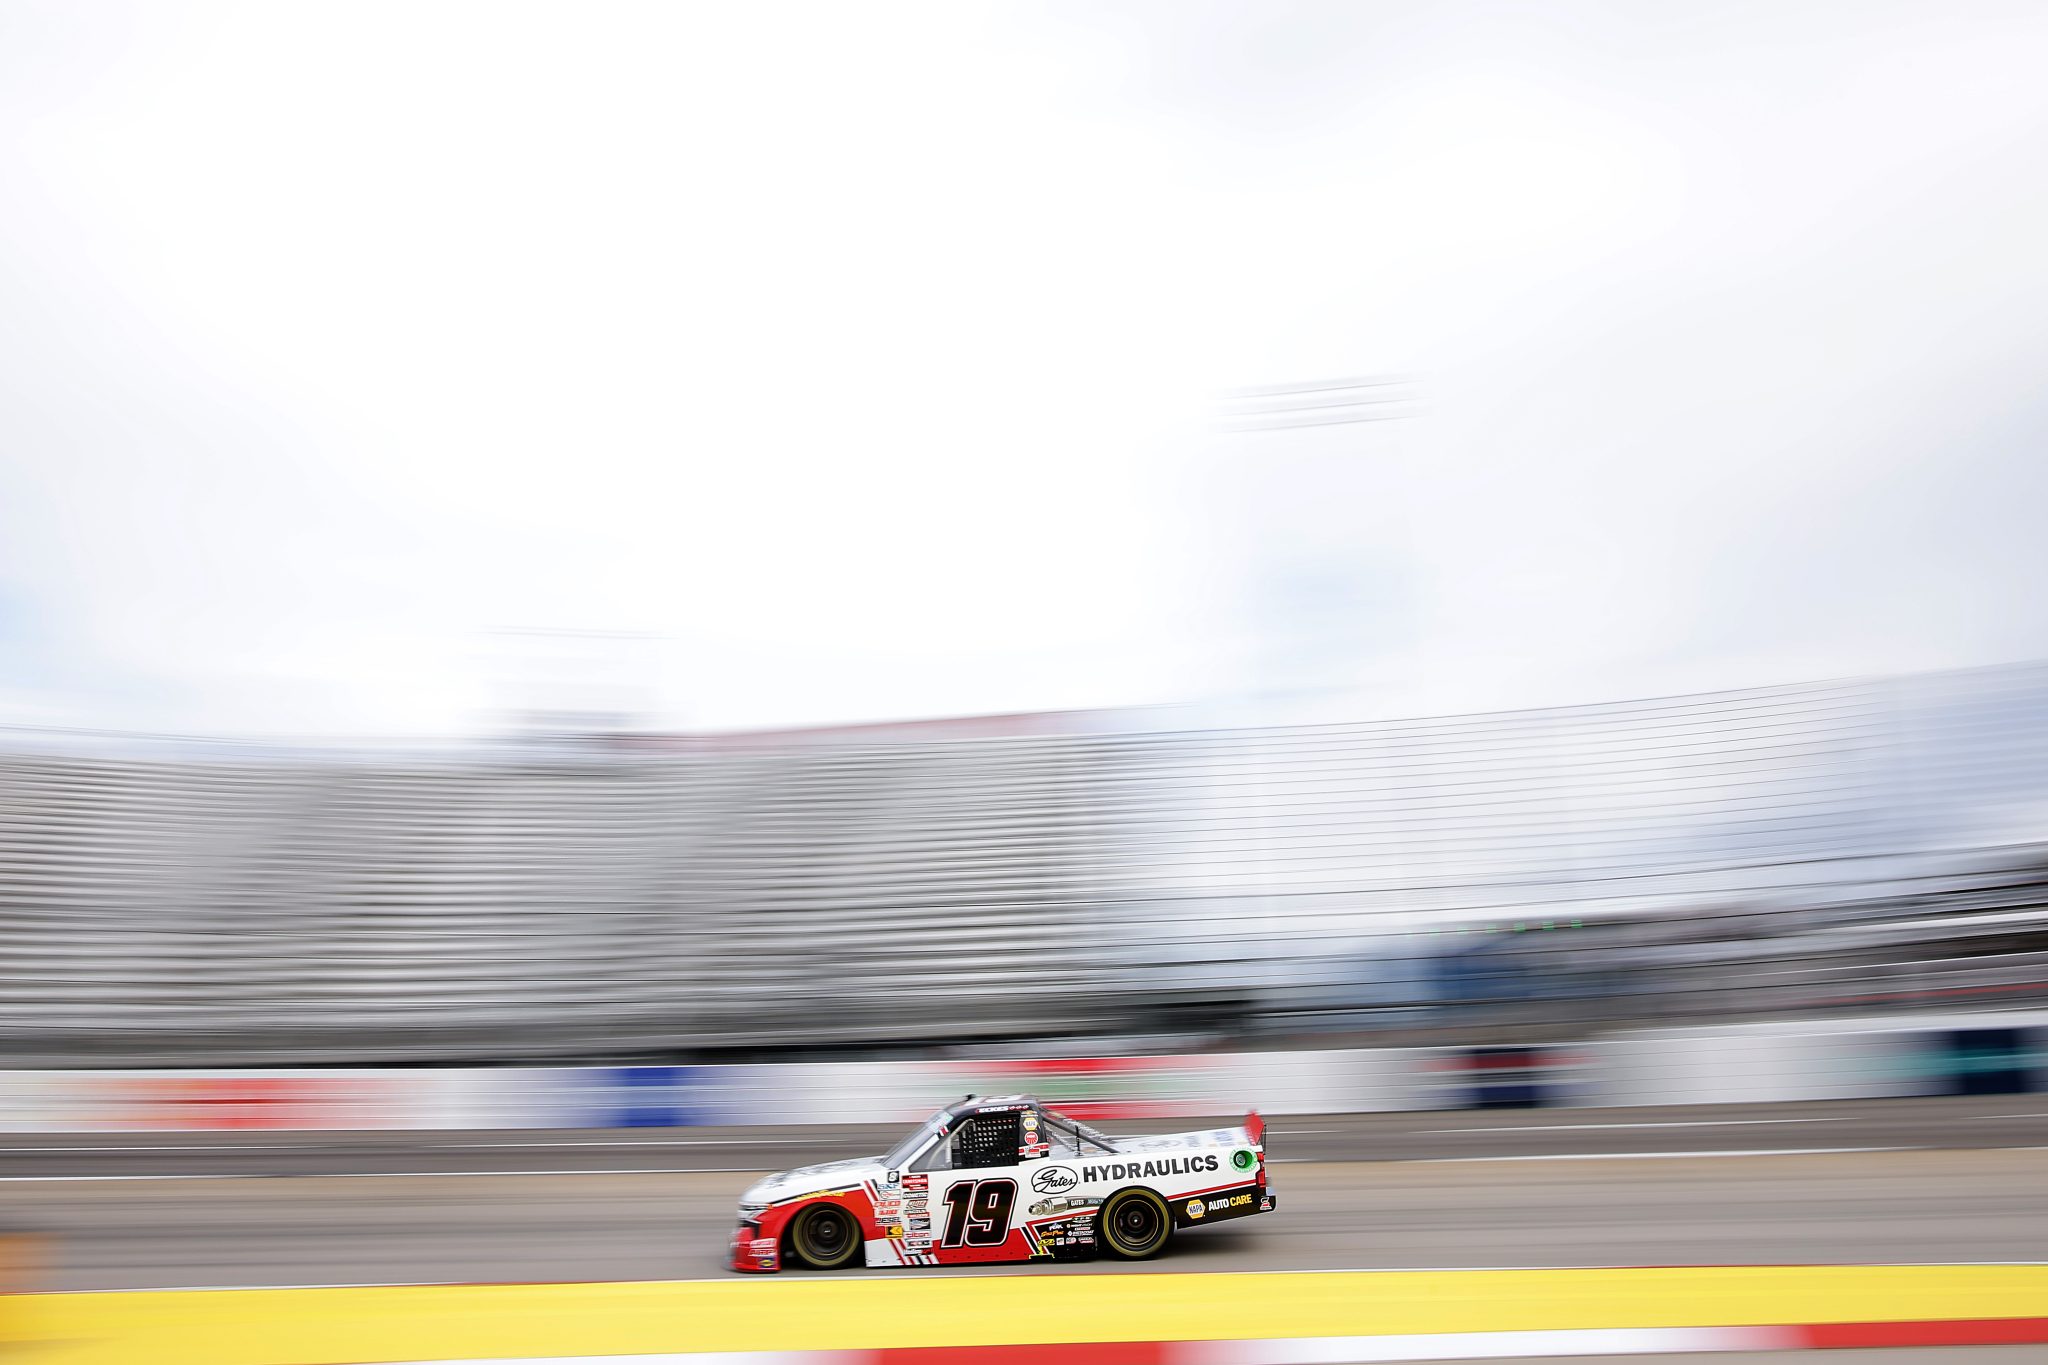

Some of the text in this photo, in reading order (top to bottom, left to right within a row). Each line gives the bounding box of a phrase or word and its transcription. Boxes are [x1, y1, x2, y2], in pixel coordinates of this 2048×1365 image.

[1034, 1169, 1075, 1192] Gates
[1083, 1155, 1218, 1183] HYDRAULICS
[941, 1177, 1019, 1250] 19
[1070, 1199, 1085, 1207] GATES
[1188, 1203, 1204, 1214] NAPA
[1208, 1198, 1230, 1211] AUTO
[1230, 1194, 1253, 1207] CARE
